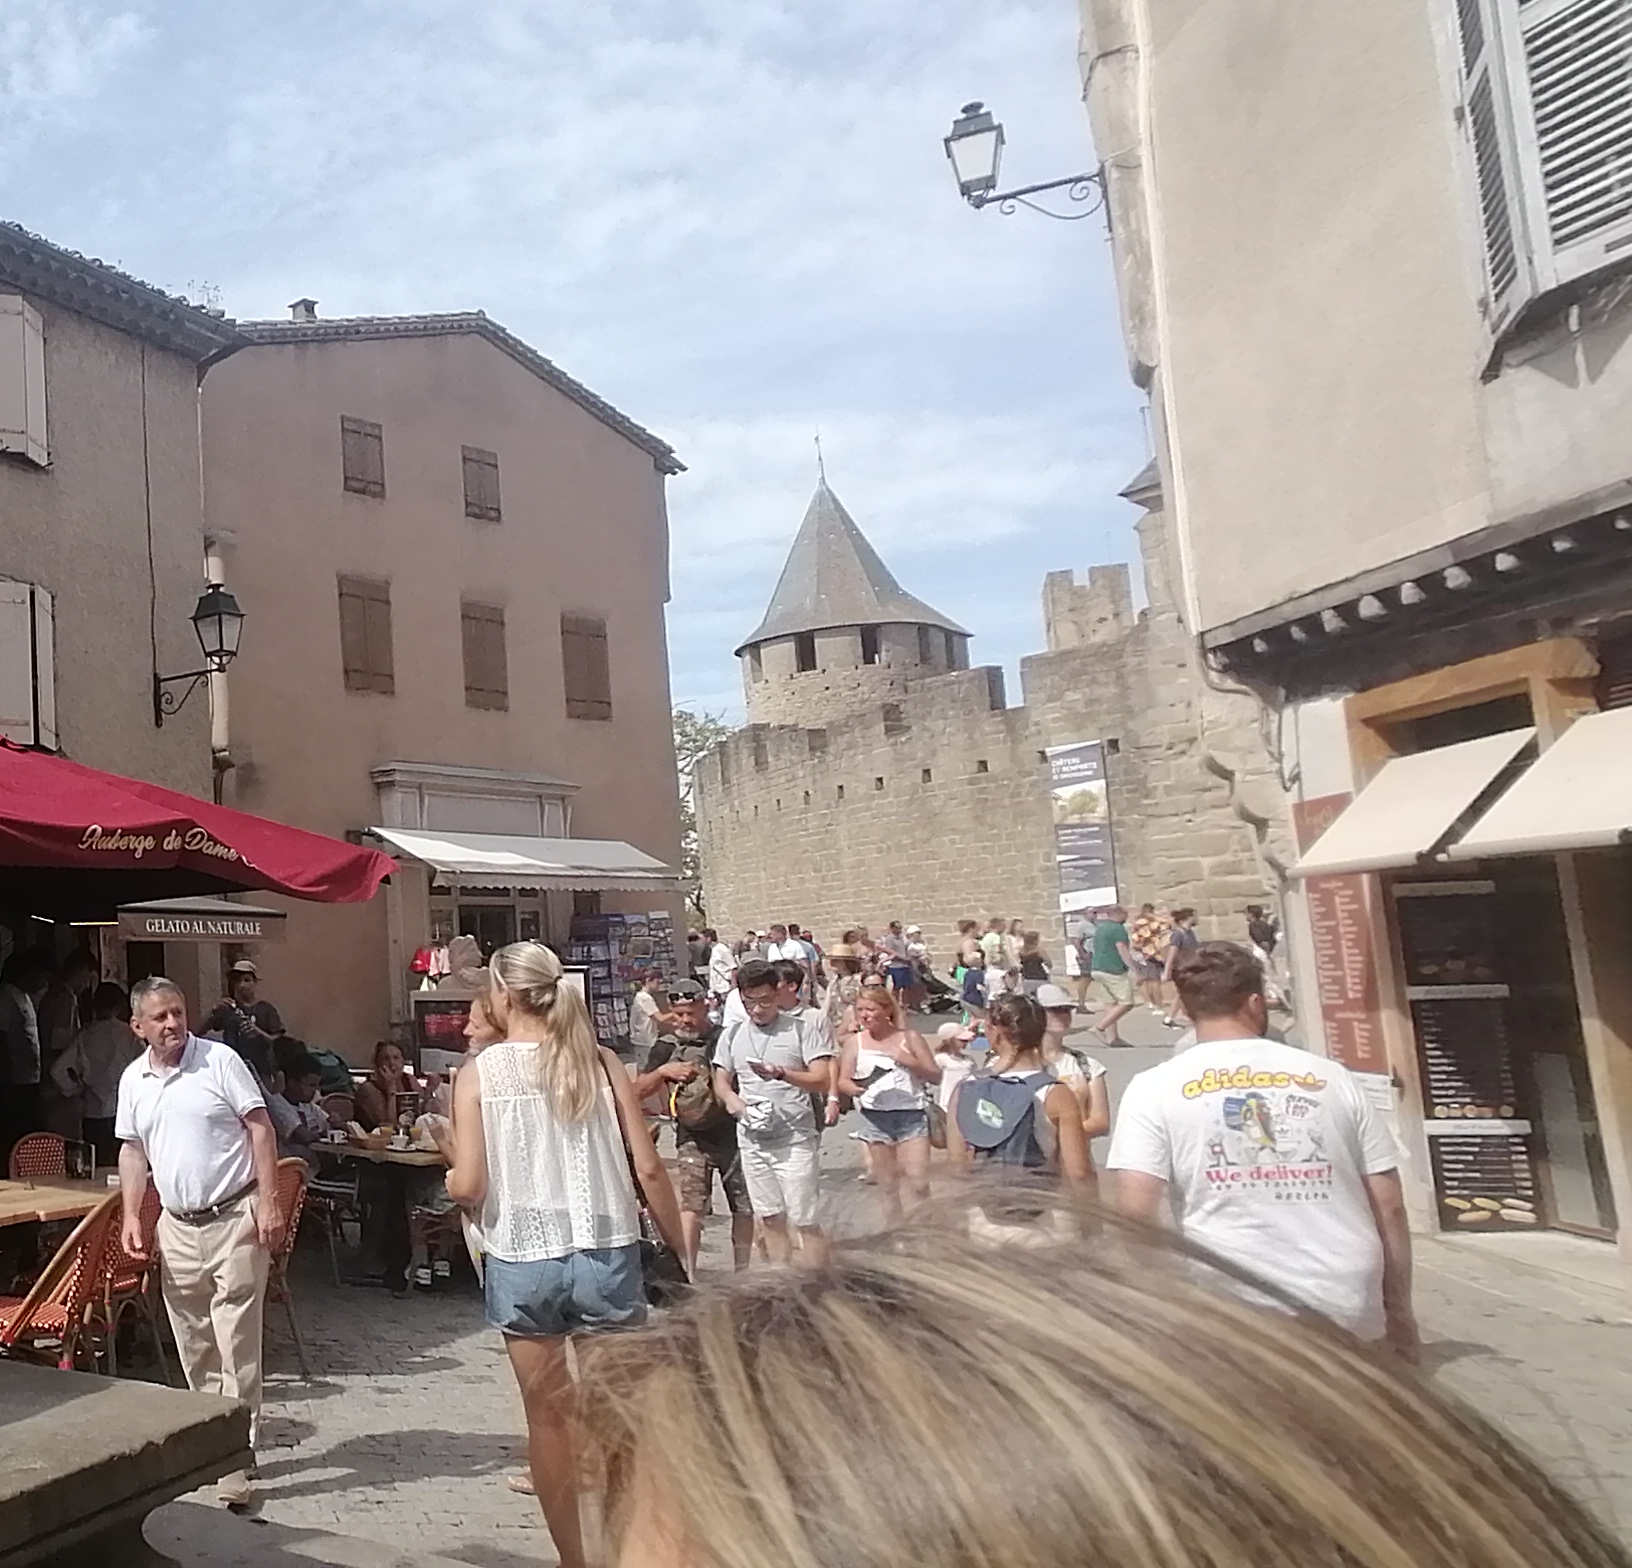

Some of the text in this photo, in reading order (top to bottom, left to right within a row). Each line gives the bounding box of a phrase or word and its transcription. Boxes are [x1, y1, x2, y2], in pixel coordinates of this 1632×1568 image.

[78, 824, 239, 862] Auberge de Dame
[145, 918, 262, 936] GELATO AL NATURALE
[1182, 1064, 1291, 1099] adidas
[1205, 1168, 1242, 1184] We
[1249, 1164, 1333, 1182] deliver!
